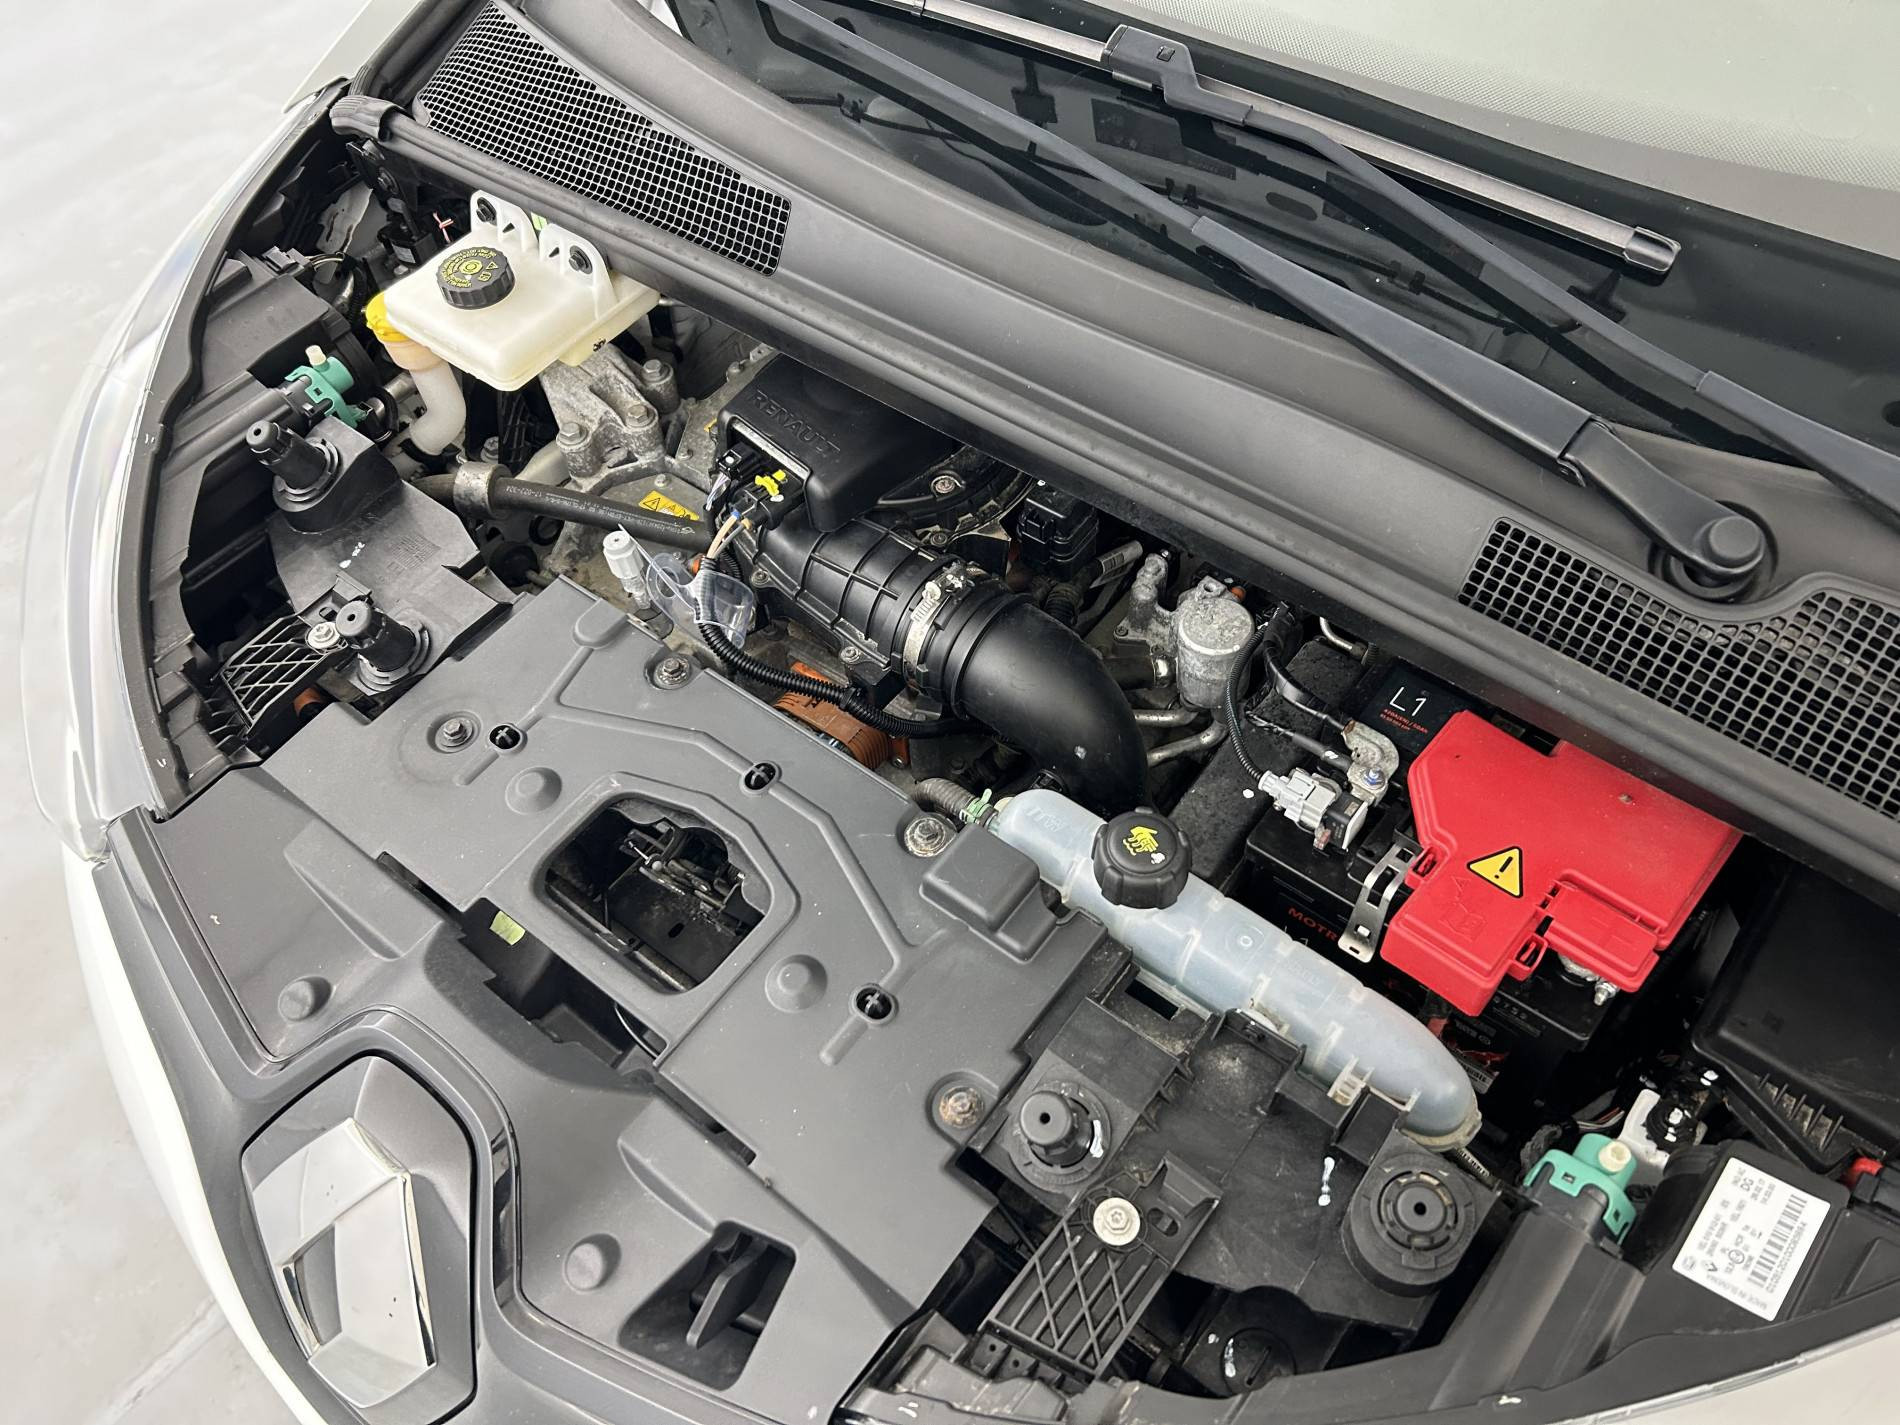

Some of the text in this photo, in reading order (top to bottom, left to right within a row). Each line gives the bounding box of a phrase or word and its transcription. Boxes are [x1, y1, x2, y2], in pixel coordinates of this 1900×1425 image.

[752, 388, 841, 457] RENAULT
[1389, 686, 1427, 717] L1
[1287, 906, 1339, 942] MOTR
